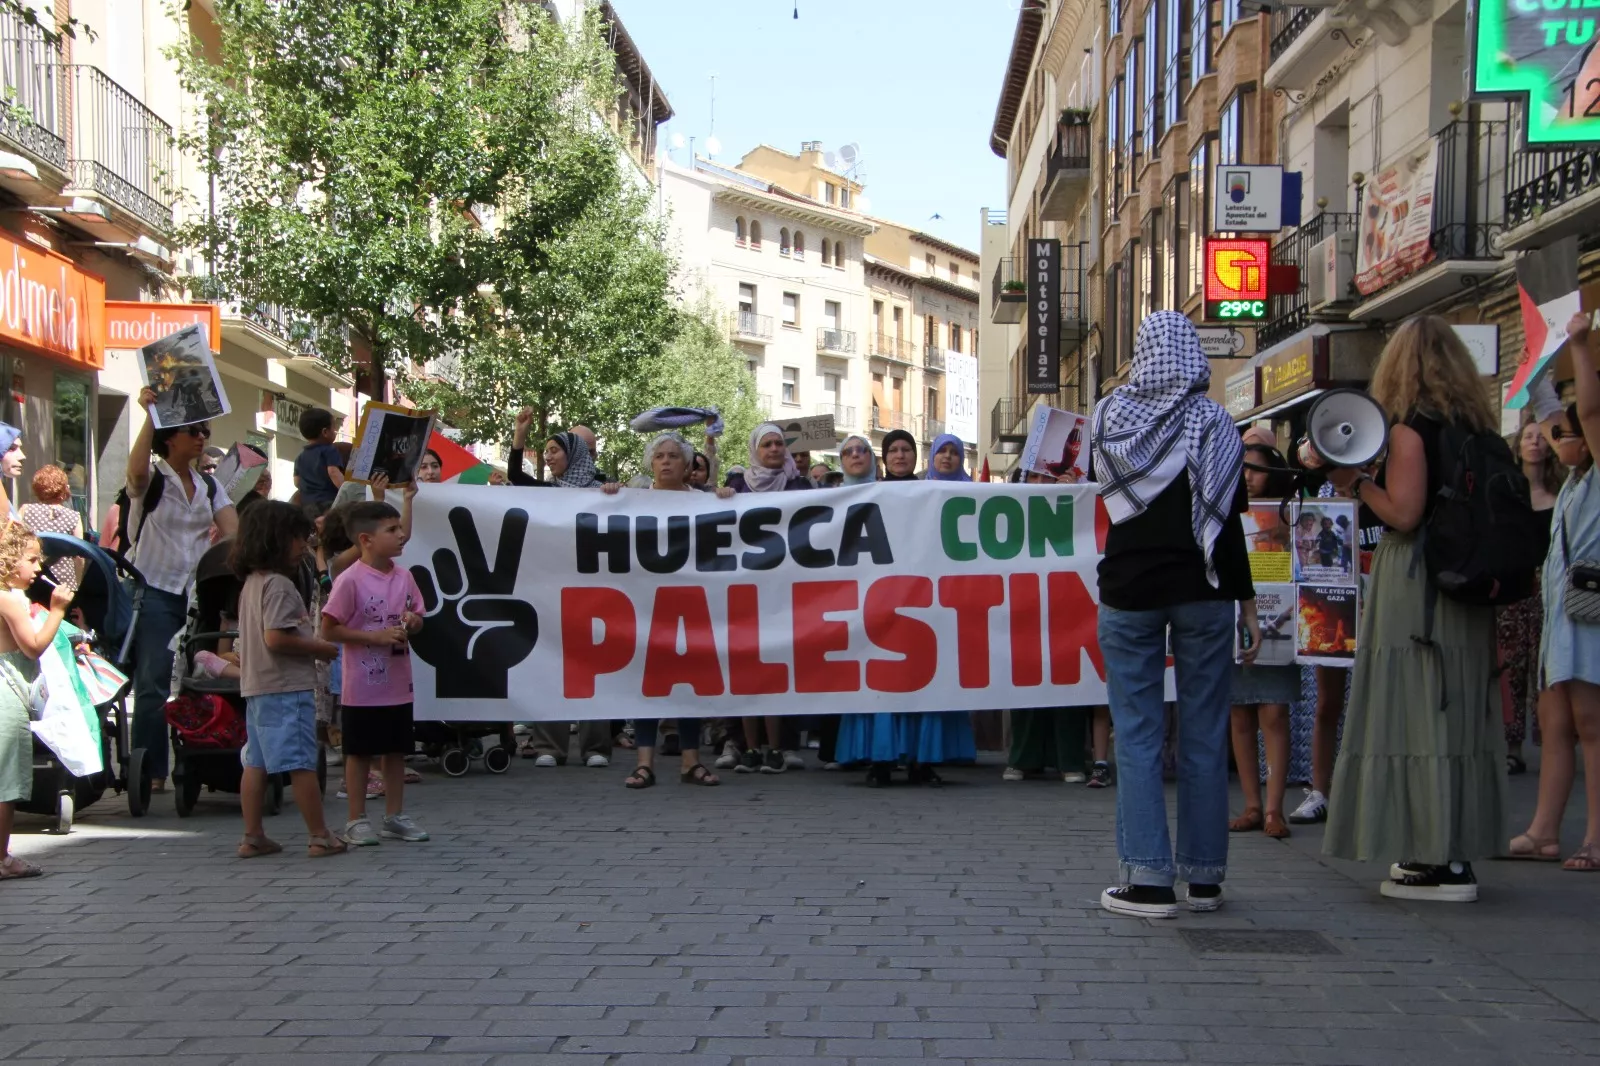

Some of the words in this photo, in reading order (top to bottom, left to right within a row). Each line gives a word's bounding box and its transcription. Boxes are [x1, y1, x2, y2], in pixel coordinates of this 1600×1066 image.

[1541, 19, 1596, 46] TU
[0, 243, 78, 353] dimela
[1036, 242, 1050, 378] Montovelaz
[110, 312, 209, 344] modim
[949, 393, 973, 417] VENTA
[807, 419, 831, 430] FREE
[575, 502, 894, 574] HUESCA
[940, 494, 1075, 562] CON
[1326, 594, 1345, 602] GAZA
[560, 571, 1107, 699] PALESTIN
